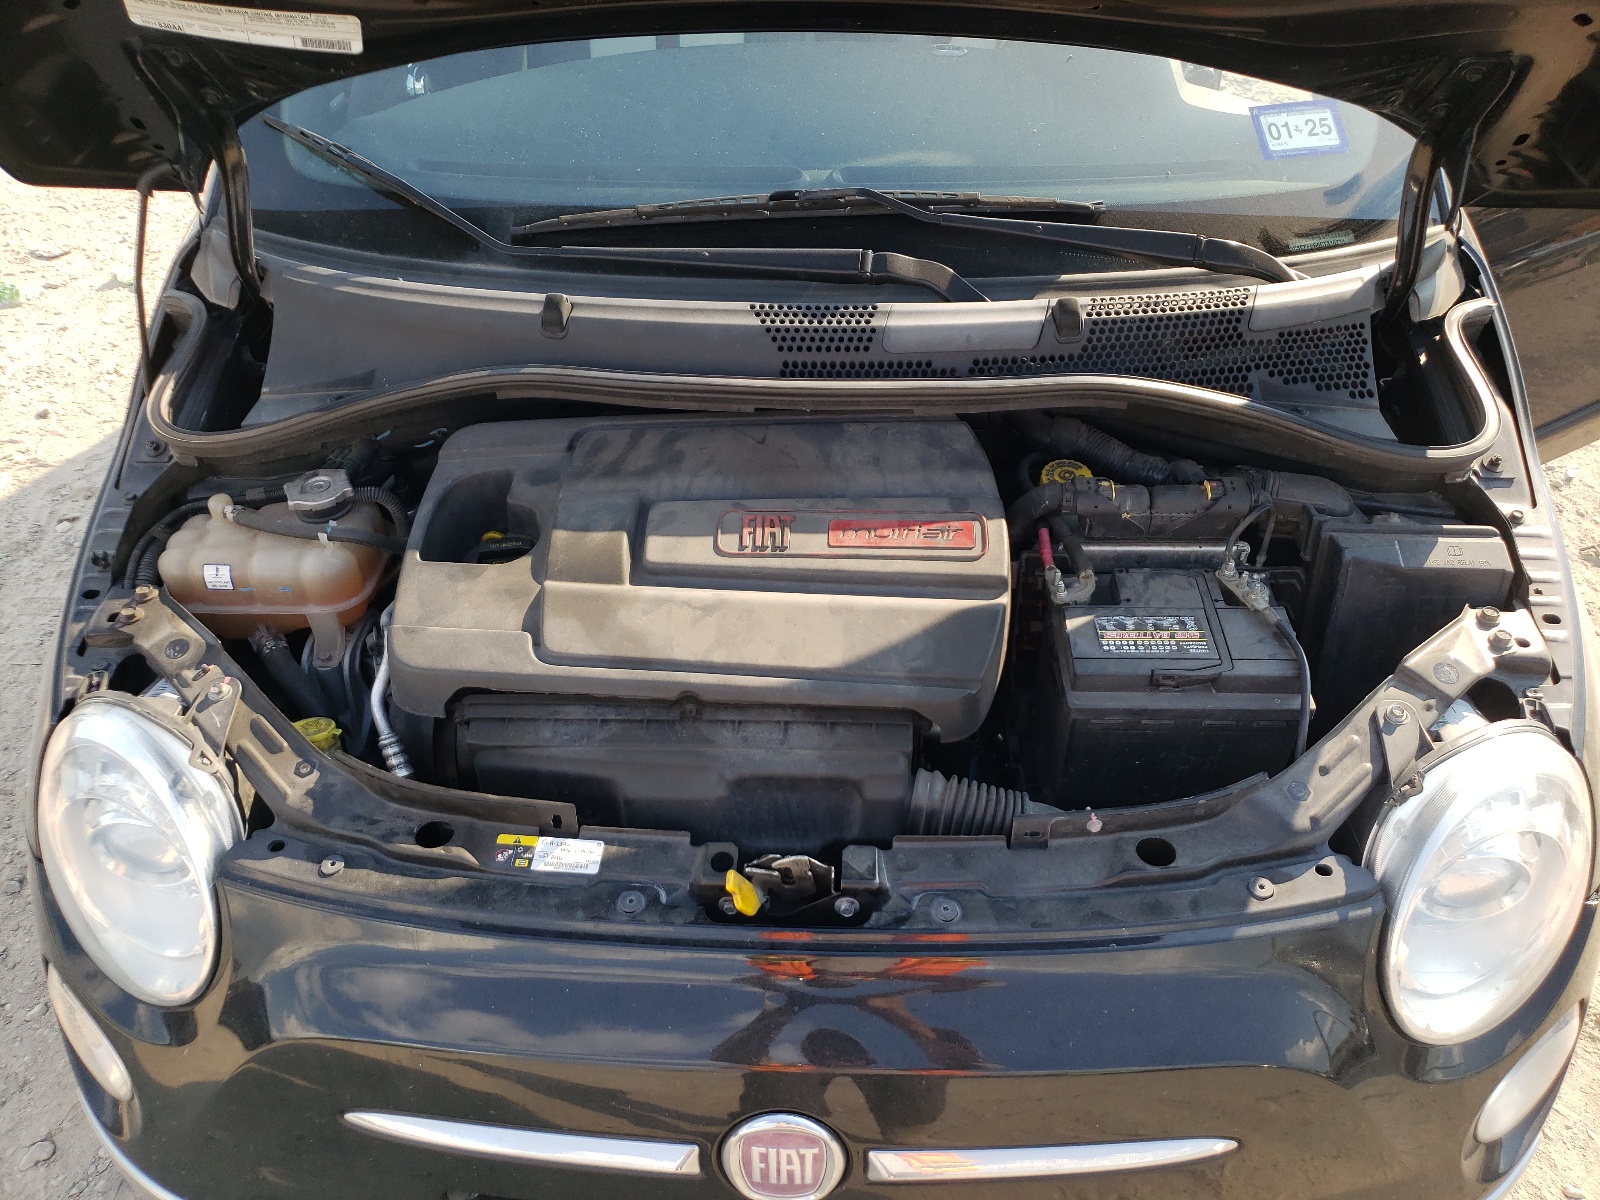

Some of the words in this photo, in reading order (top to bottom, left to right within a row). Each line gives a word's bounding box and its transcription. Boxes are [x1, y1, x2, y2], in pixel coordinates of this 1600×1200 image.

[1267, 121, 1293, 141] 01
[1304, 117, 1333, 137] 25
[739, 514, 796, 551] FIAT
[838, 523, 964, 541] multiair
[751, 1146, 819, 1185] FIAT
